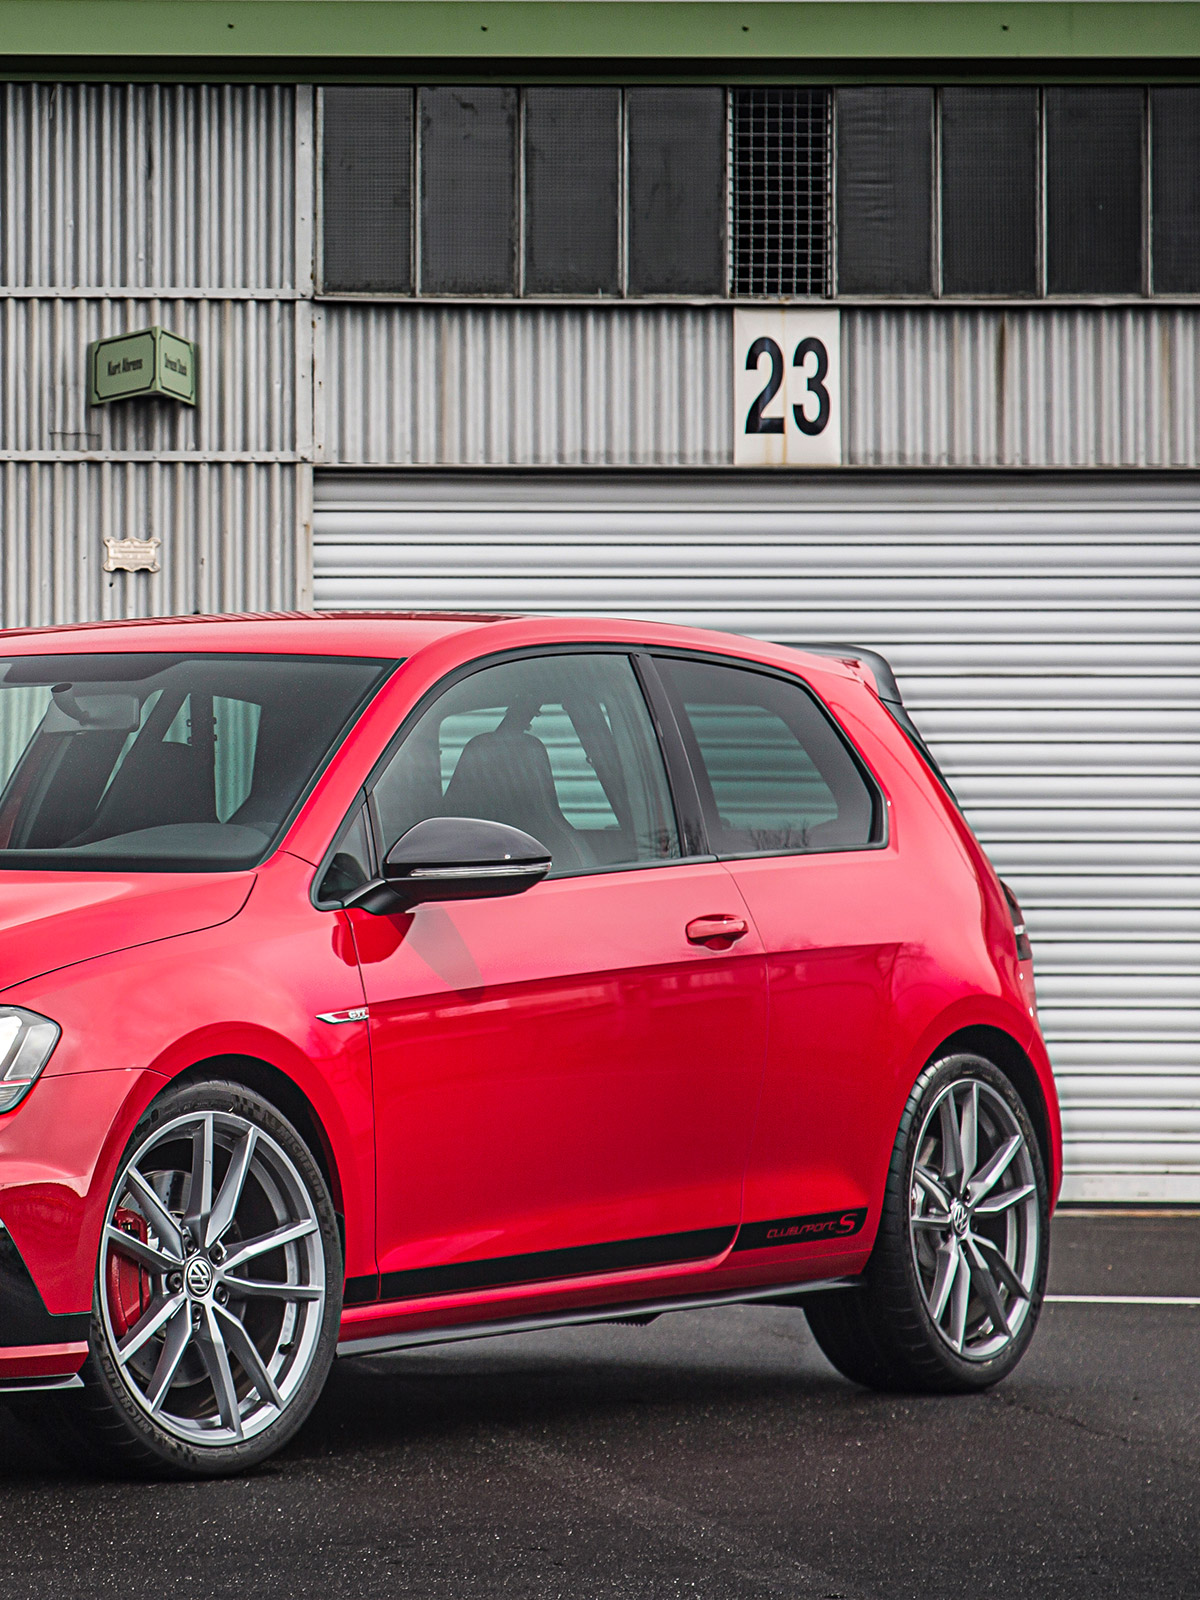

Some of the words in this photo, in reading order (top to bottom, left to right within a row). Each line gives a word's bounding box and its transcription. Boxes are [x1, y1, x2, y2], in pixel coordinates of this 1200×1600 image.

[745, 336, 831, 436] 23
[276, 1127, 326, 1200] MICHELIN
[836, 1212, 858, 1234] S
[102, 1356, 153, 1434] MICHELIN
